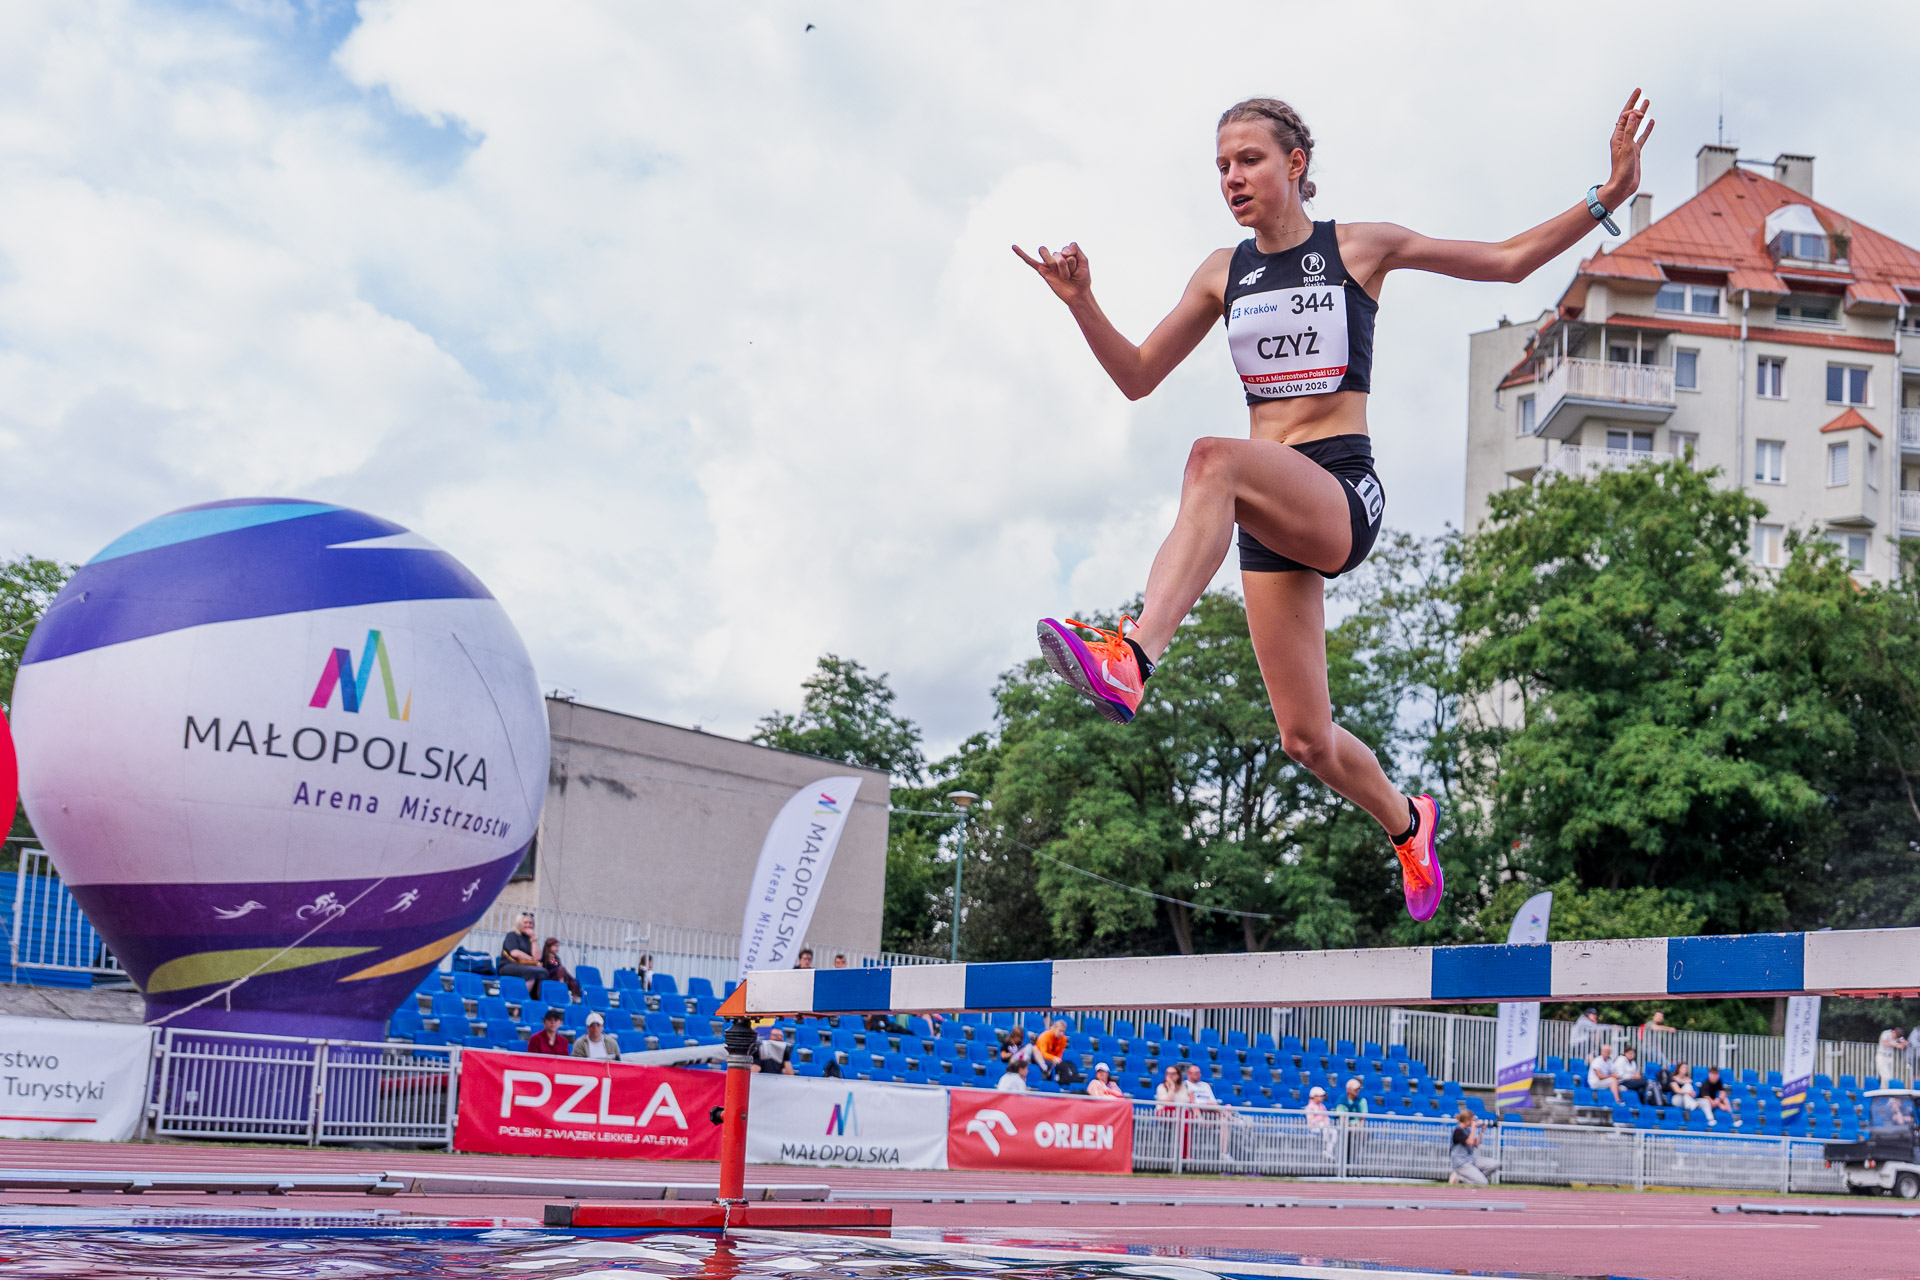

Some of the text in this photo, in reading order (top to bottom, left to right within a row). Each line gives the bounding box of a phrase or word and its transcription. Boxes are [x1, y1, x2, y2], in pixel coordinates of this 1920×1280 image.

[1239, 266, 1267, 286] 4F
[1303, 274, 1327, 284] RUDA
[1244, 303, 1278, 316] Kraków
[1290, 292, 1335, 315] 344
[1257, 325, 1320, 360] CZYŻ
[1256, 375, 1271, 383] PZLA
[1271, 372, 1308, 382] Mistrzostwa
[1308, 370, 1327, 378] Polski
[1327, 368, 1340, 376] U23
[1259, 381, 1328, 395] KRAKÓW 2026
[1363, 479, 1381, 518] 10
[184, 715, 488, 791] MAŁOPOLSKA
[293, 781, 512, 839] Arena Mistrzostw
[764, 863, 787, 902] Arena
[768, 822, 828, 963] MAŁOPOLSKA
[0, 1048, 59, 1070] stwo
[4, 1075, 105, 1103] Turystyki
[500, 1069, 689, 1130] PZLA
[499, 1125, 689, 1147] POLSKI ZWIĄZEK LEKKIEJ ATLETYKI
[1033, 1120, 1114, 1151] ORLEN
[779, 1142, 900, 1164] MAŁOPOLSKA
